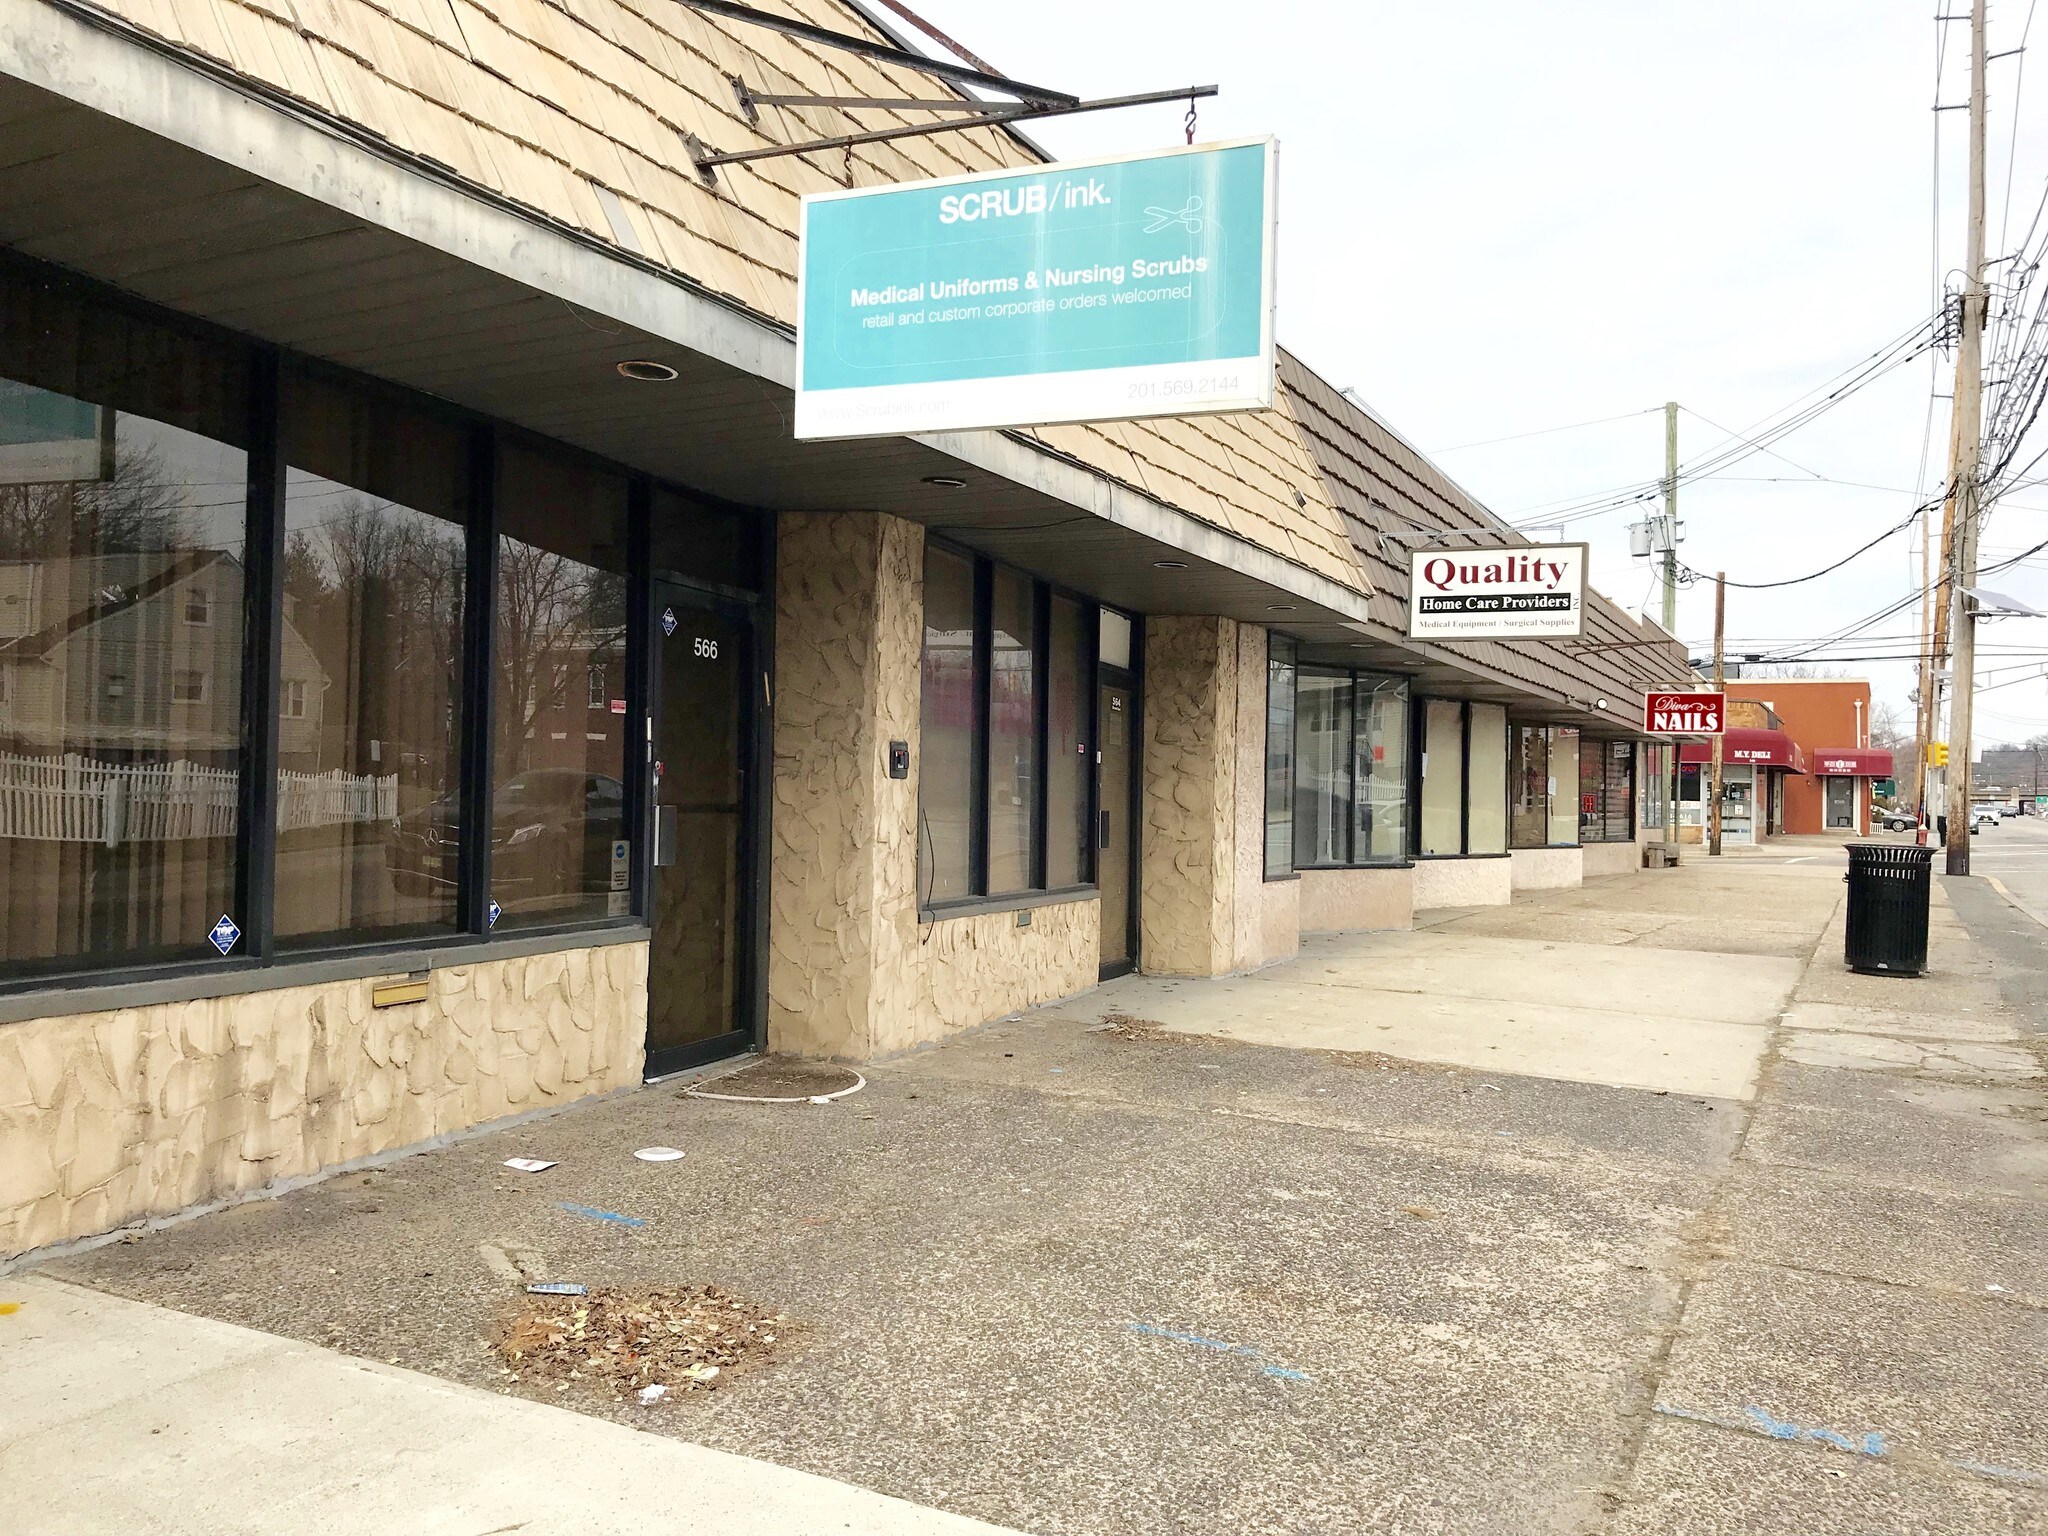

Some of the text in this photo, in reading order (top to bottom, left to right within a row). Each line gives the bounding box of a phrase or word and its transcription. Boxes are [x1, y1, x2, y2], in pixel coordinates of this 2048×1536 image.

[851, 255, 1208, 307] Medical Uniforms & Nursing Scrubs
[862, 281, 1192, 328] retail and custom corporate orders welcomed
[1128, 376, 1239, 398] 201.569.2144
[1424, 555, 1569, 591] Quality
[1422, 596, 1569, 610] Home Care Providers
[1419, 620, 1450, 628] Medical
[1452, 620, 1497, 629] Equipment
[1503, 619, 1538, 627] Surgical
[1539, 618, 1575, 627] Supplies
[694, 637, 718, 659] 566
[1654, 696, 1694, 710] Diva
[1654, 712, 1718, 731] NAILS
[1751, 751, 1771, 759] DELI
